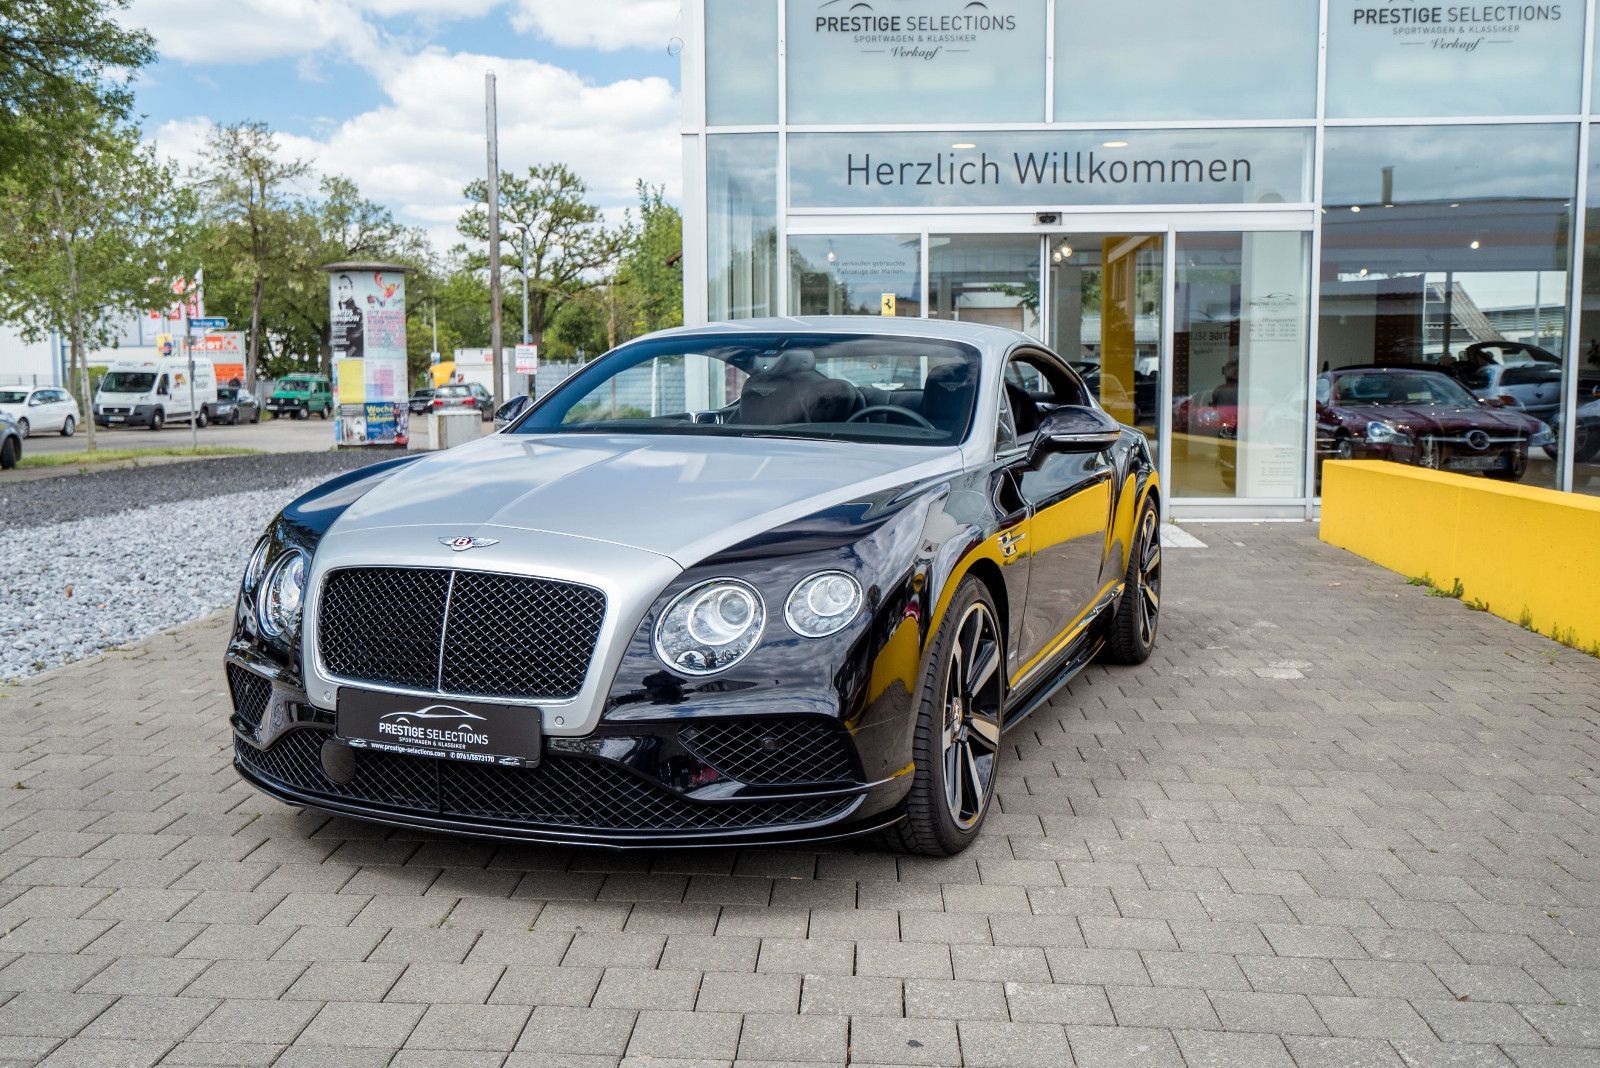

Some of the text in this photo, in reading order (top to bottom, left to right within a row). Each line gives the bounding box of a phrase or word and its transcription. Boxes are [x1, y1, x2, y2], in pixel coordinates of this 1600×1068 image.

[1353, 5, 1562, 24] PRESTIGE SELECTIONS
[816, 15, 1016, 32] PRESTIGE SELECTIONS
[1392, 25, 1520, 35] SPORTWAGEN & KLASSIKER
[853, 34, 976, 43] SPORTWAGEN & KLASSIKER
[1431, 36, 1485, 51] Verkauf
[890, 46, 942, 60] Verkauf
[847, 151, 1252, 186] Herzlich Willkommen
[379, 722, 489, 746] PRESTIGE SELECTIONS
[398, 736, 432, 746] SPORTWAGEN
[438, 741, 466, 750] KLASSIKER
[370, 742, 446, 758] www.prestige-selections.com
[456, 752, 495, 763] 0761/5573170
